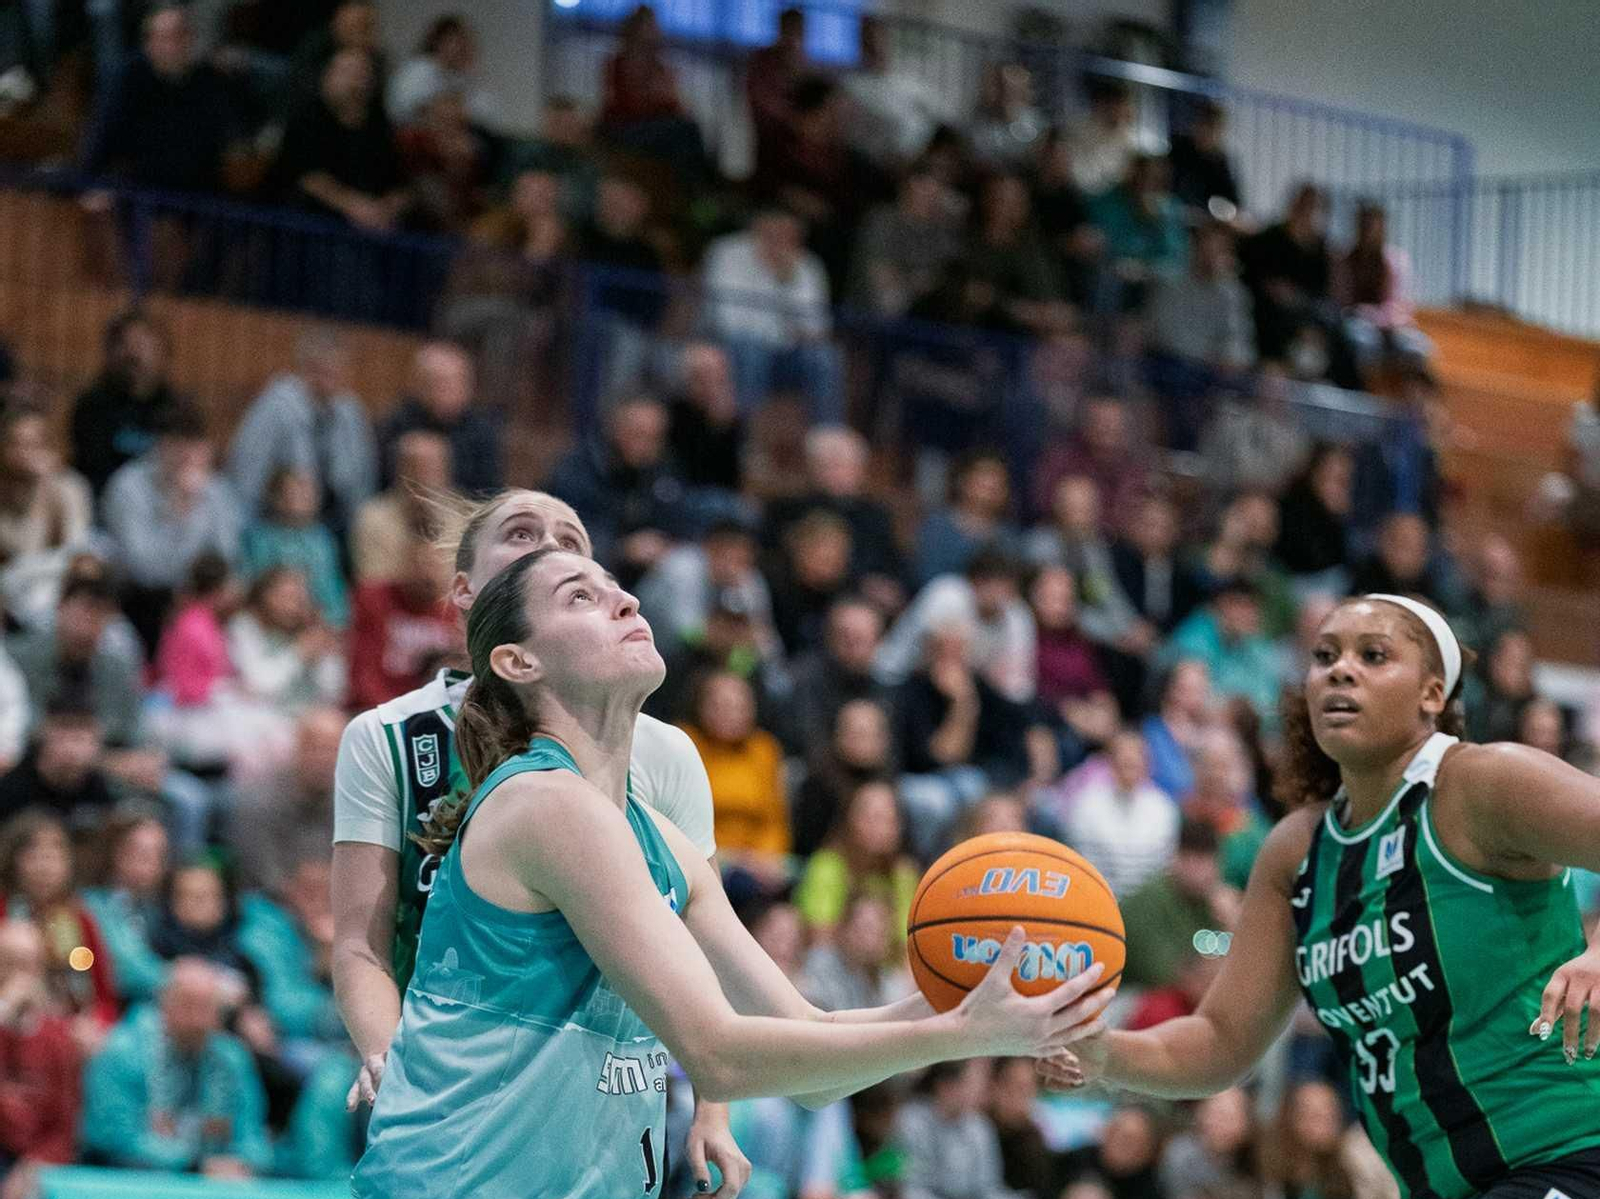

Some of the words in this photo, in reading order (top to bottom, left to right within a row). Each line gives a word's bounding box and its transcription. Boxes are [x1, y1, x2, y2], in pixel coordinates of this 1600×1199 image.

[418, 738, 437, 783] CJB
[979, 868, 1070, 899] EVO
[952, 932, 1094, 981] Wilon
[1296, 911, 1416, 987] GRIFOLS
[1317, 962, 1435, 1028] OVENTUT
